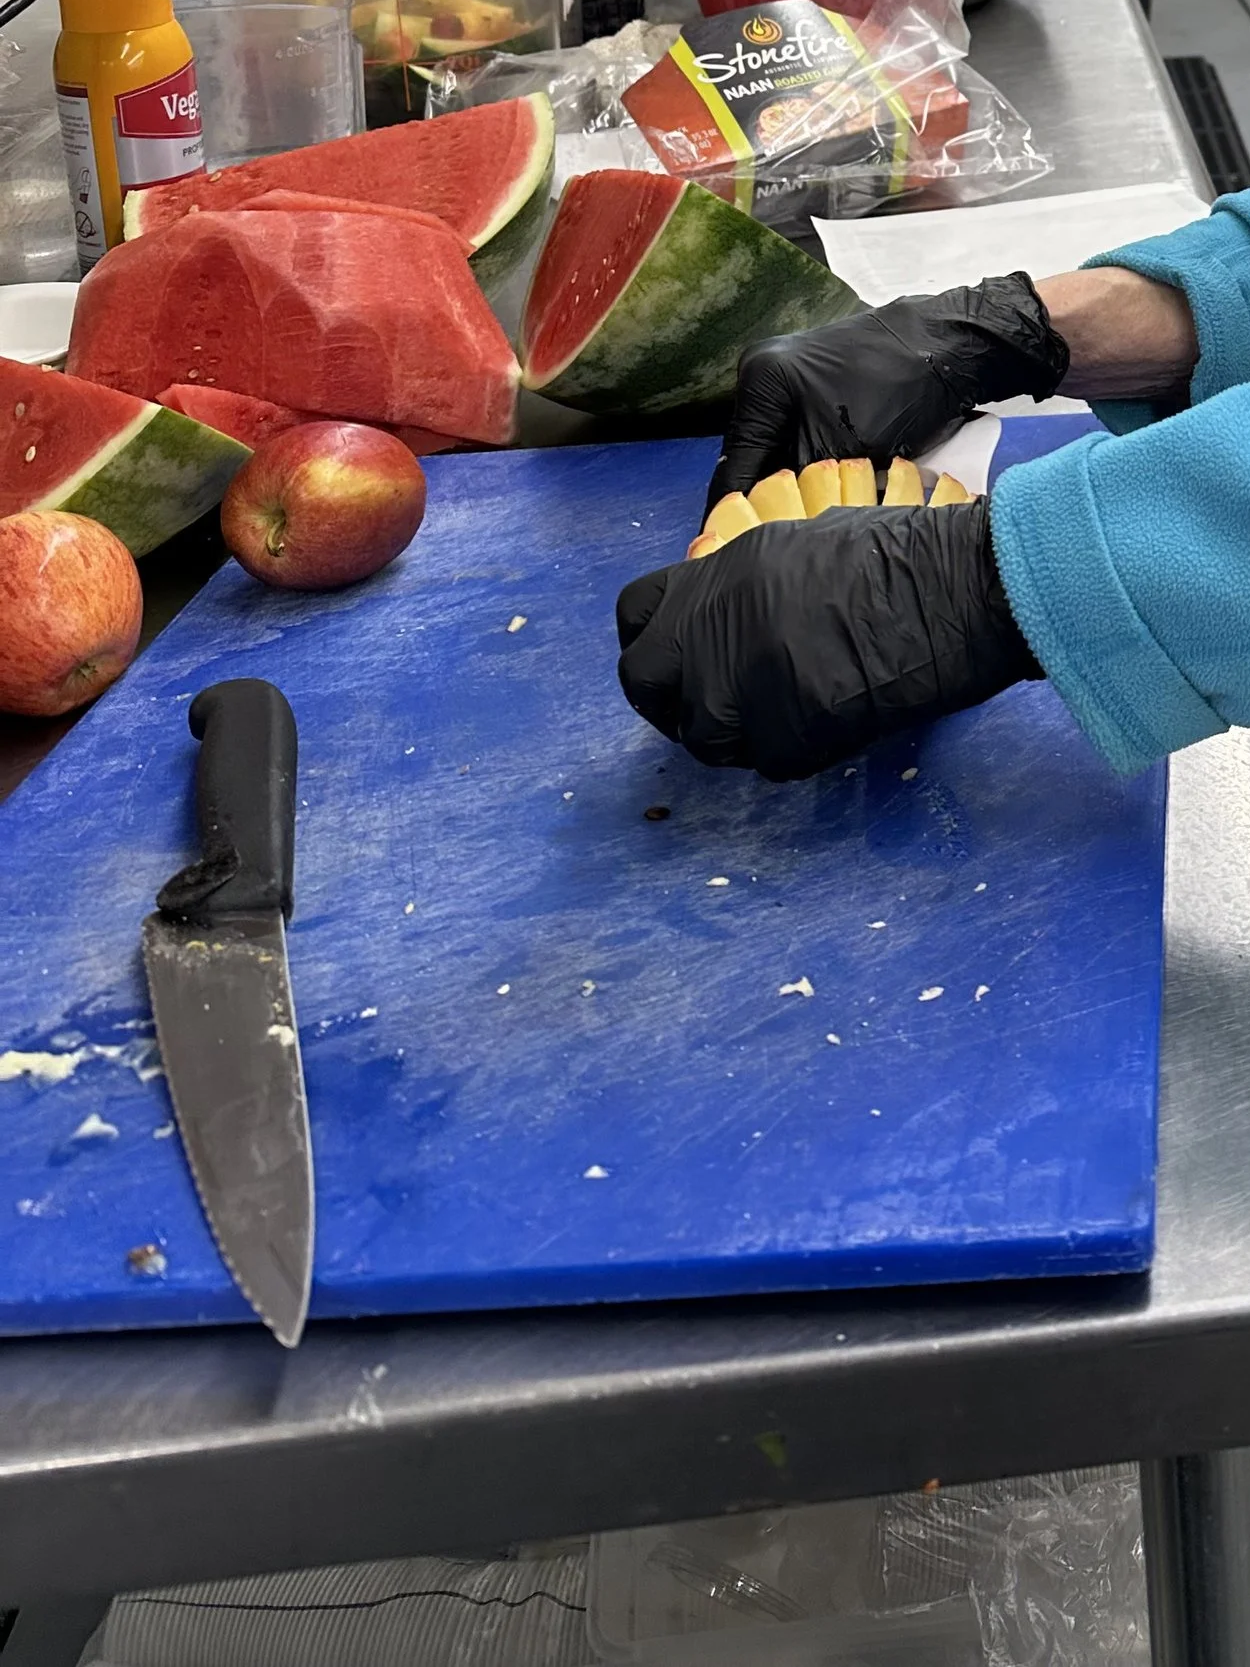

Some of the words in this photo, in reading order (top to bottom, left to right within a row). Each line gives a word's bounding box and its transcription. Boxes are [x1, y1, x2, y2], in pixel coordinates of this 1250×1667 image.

[693, 18, 856, 84] Stonefire
[723, 77, 775, 101] NAAN
[774, 70, 823, 90] ROASTED
[756, 178, 803, 200] NAAN
